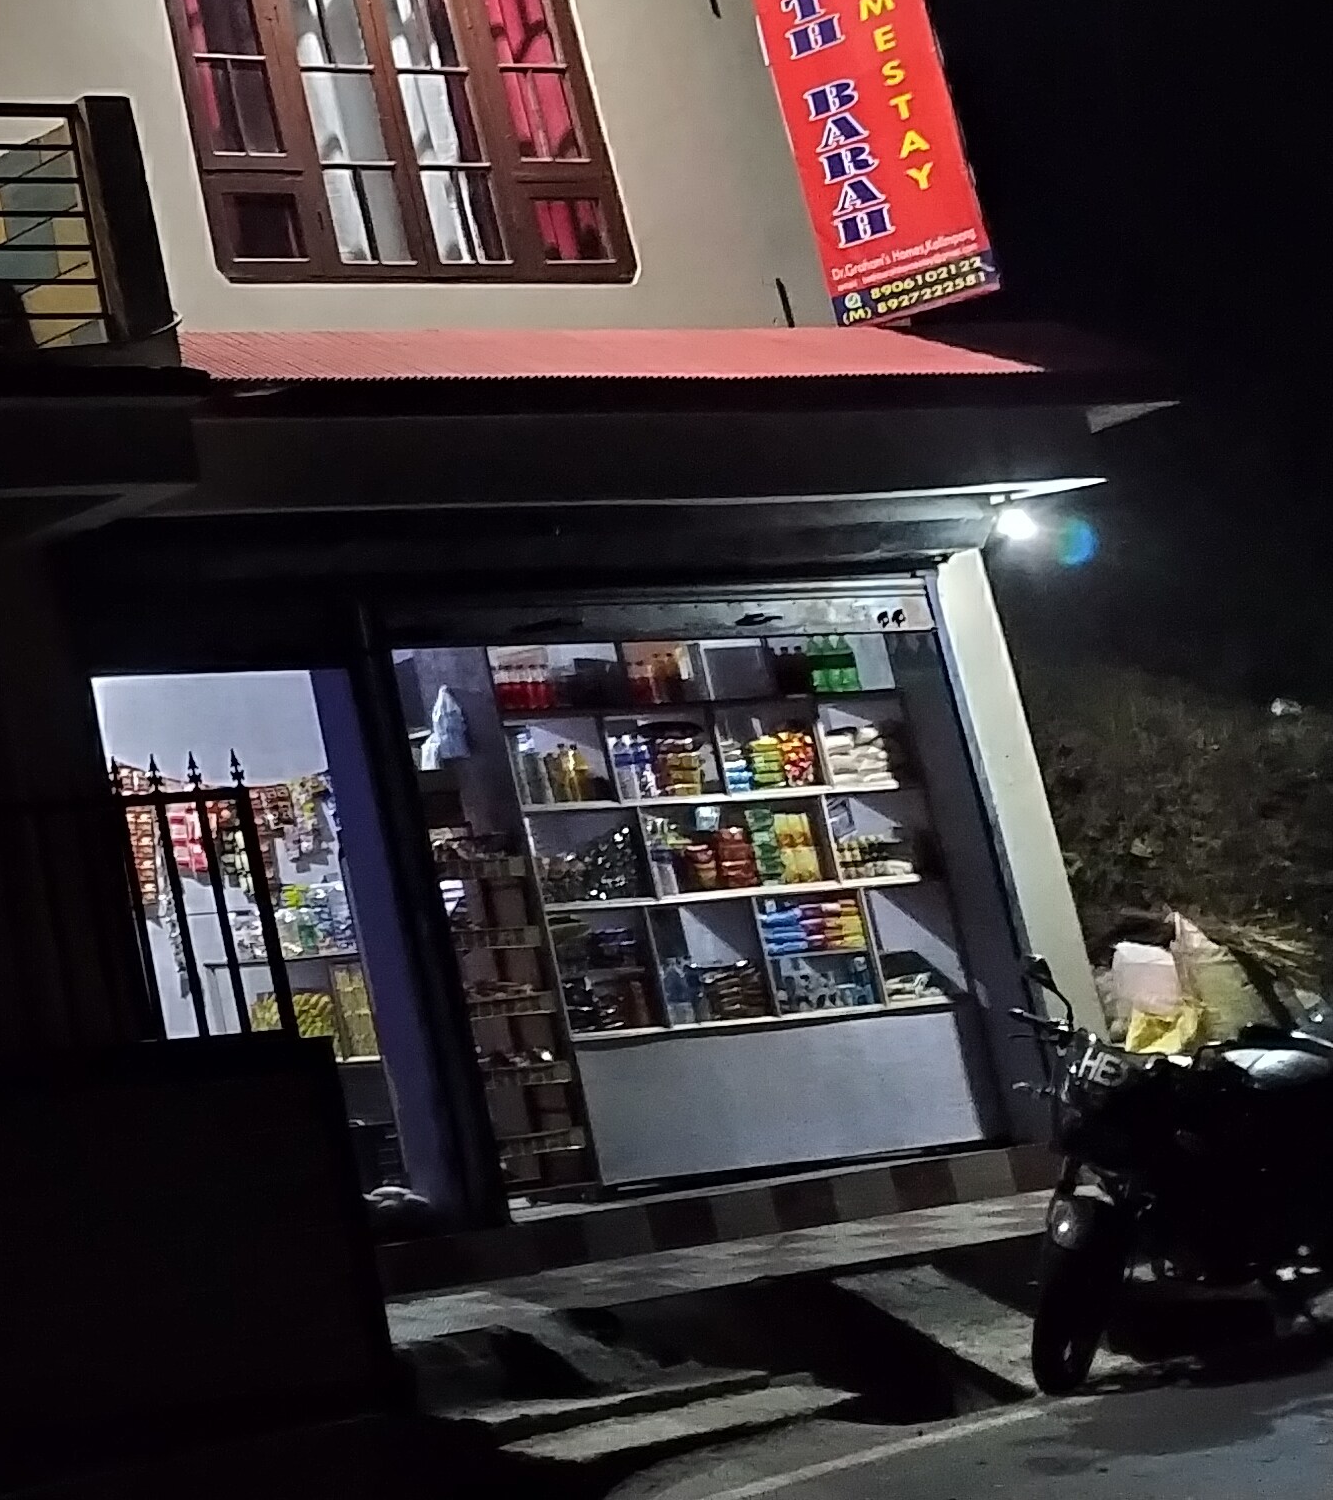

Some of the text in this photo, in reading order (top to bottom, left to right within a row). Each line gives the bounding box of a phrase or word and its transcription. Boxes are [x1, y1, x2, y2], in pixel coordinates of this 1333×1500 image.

[802, 79, 896, 249] BARAH
[842, 271, 986, 325] (M) 8927222581
[870, 256, 982, 300] 8906102122
